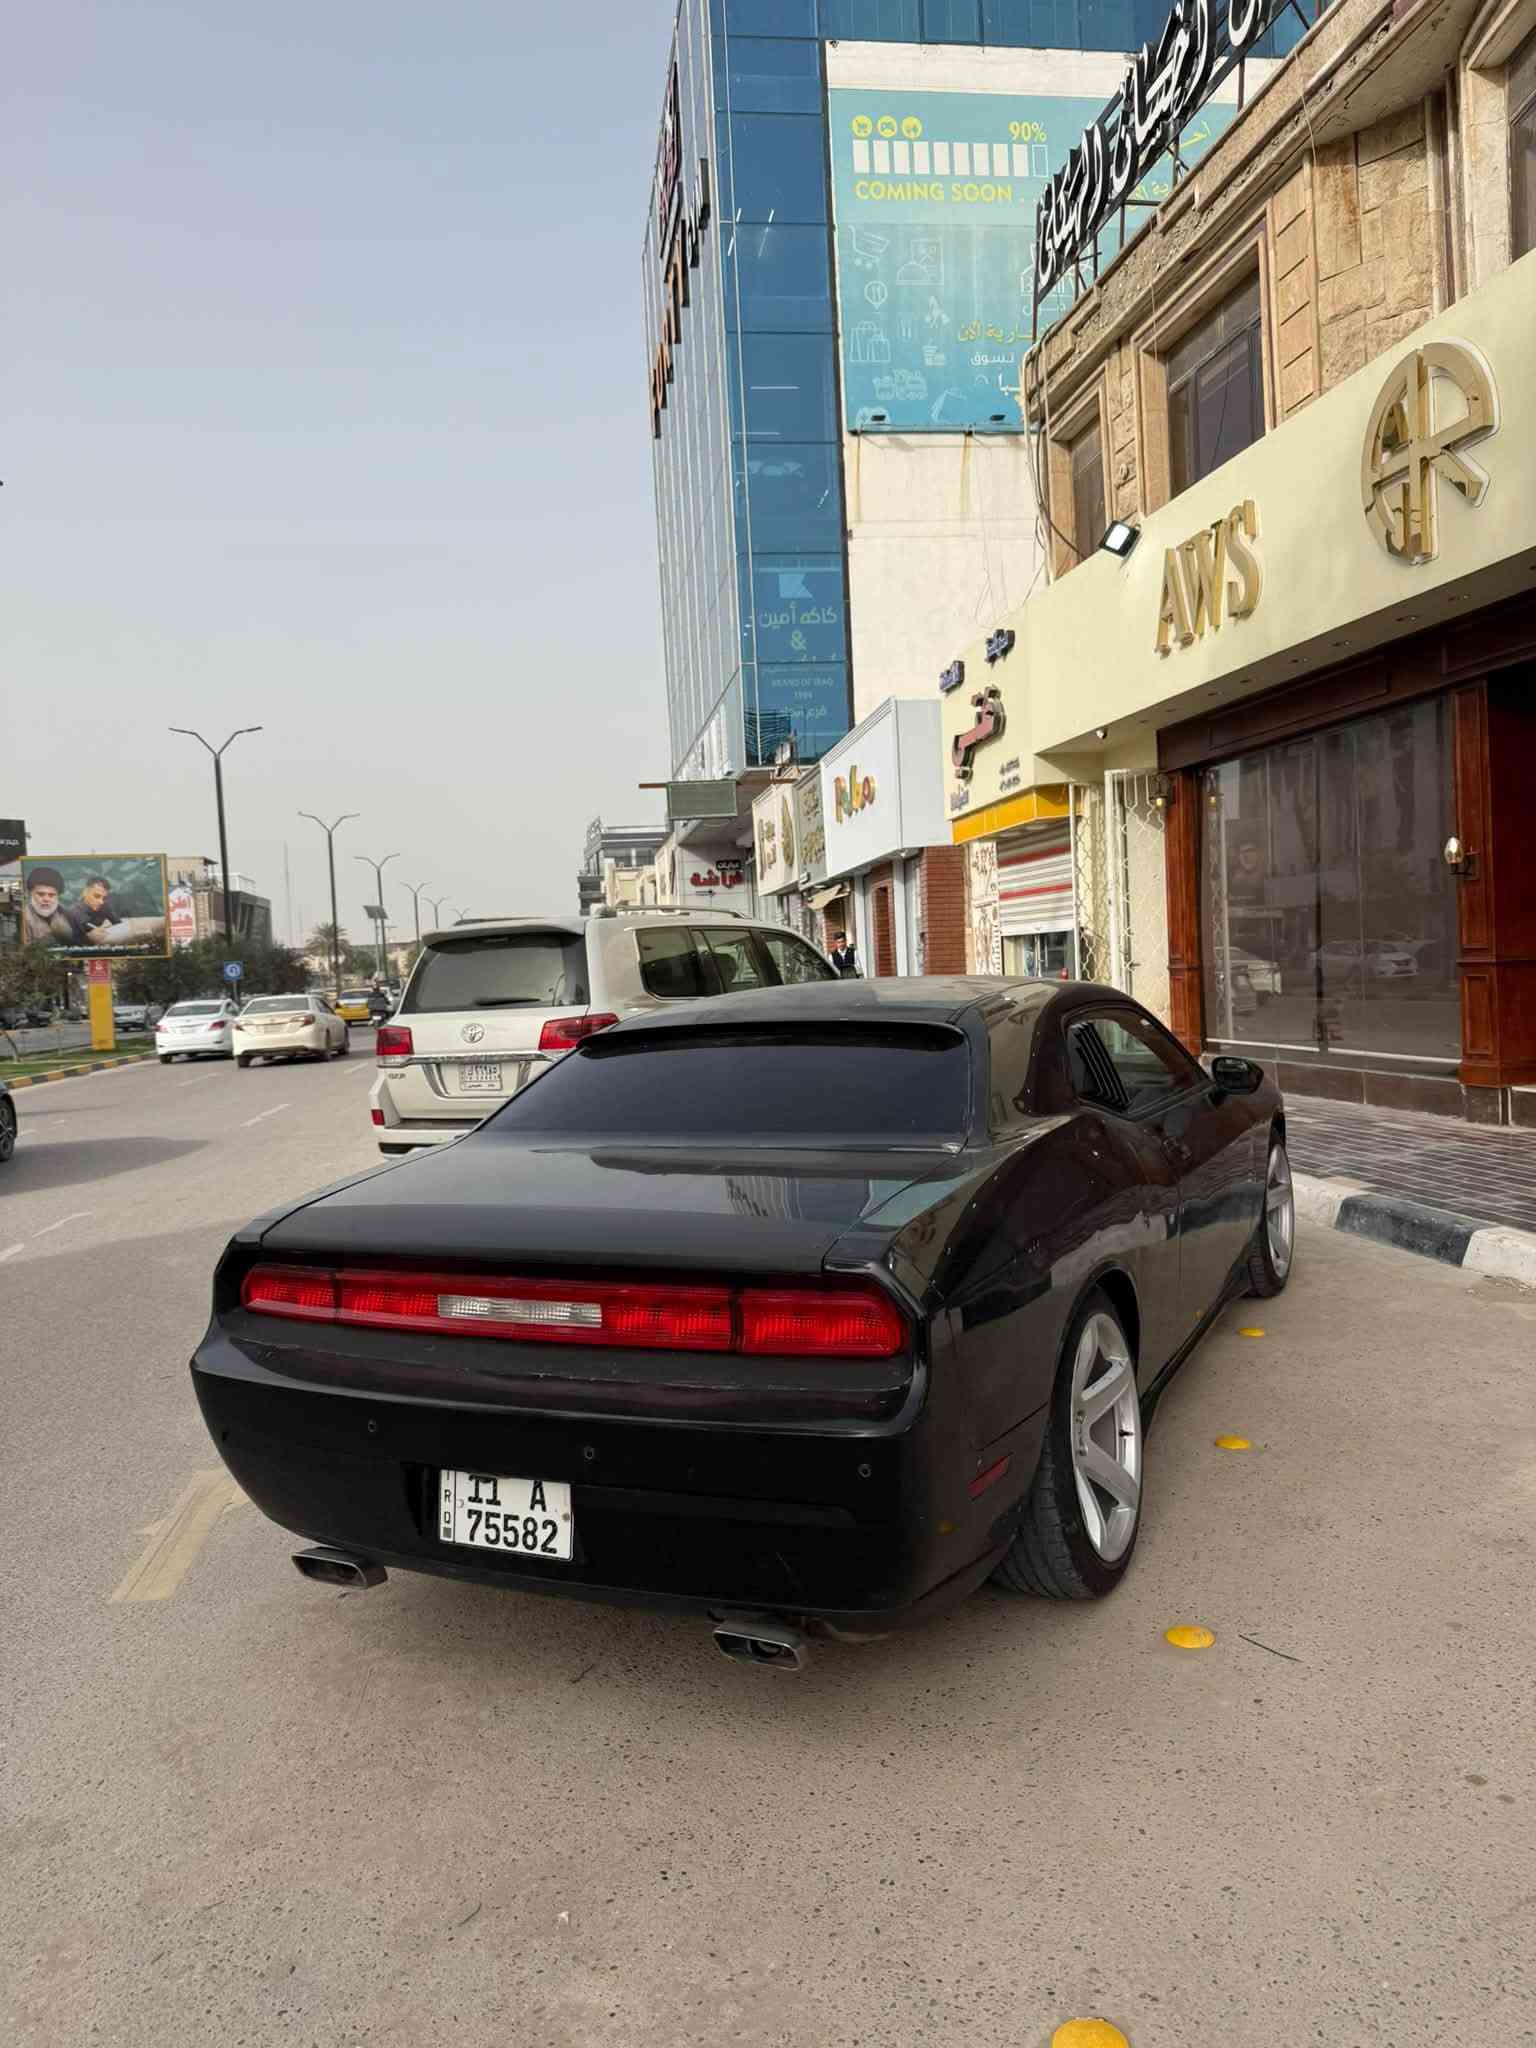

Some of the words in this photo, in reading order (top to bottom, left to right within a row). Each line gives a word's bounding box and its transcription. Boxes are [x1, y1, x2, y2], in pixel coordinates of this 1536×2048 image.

[1008, 121, 1047, 142] 90%
[855, 180, 944, 201] COMING
[1155, 499, 1262, 658] AWS
[791, 630, 807, 650] &
[530, 1480, 547, 1512] A
[467, 1509, 558, 1554] 75582
